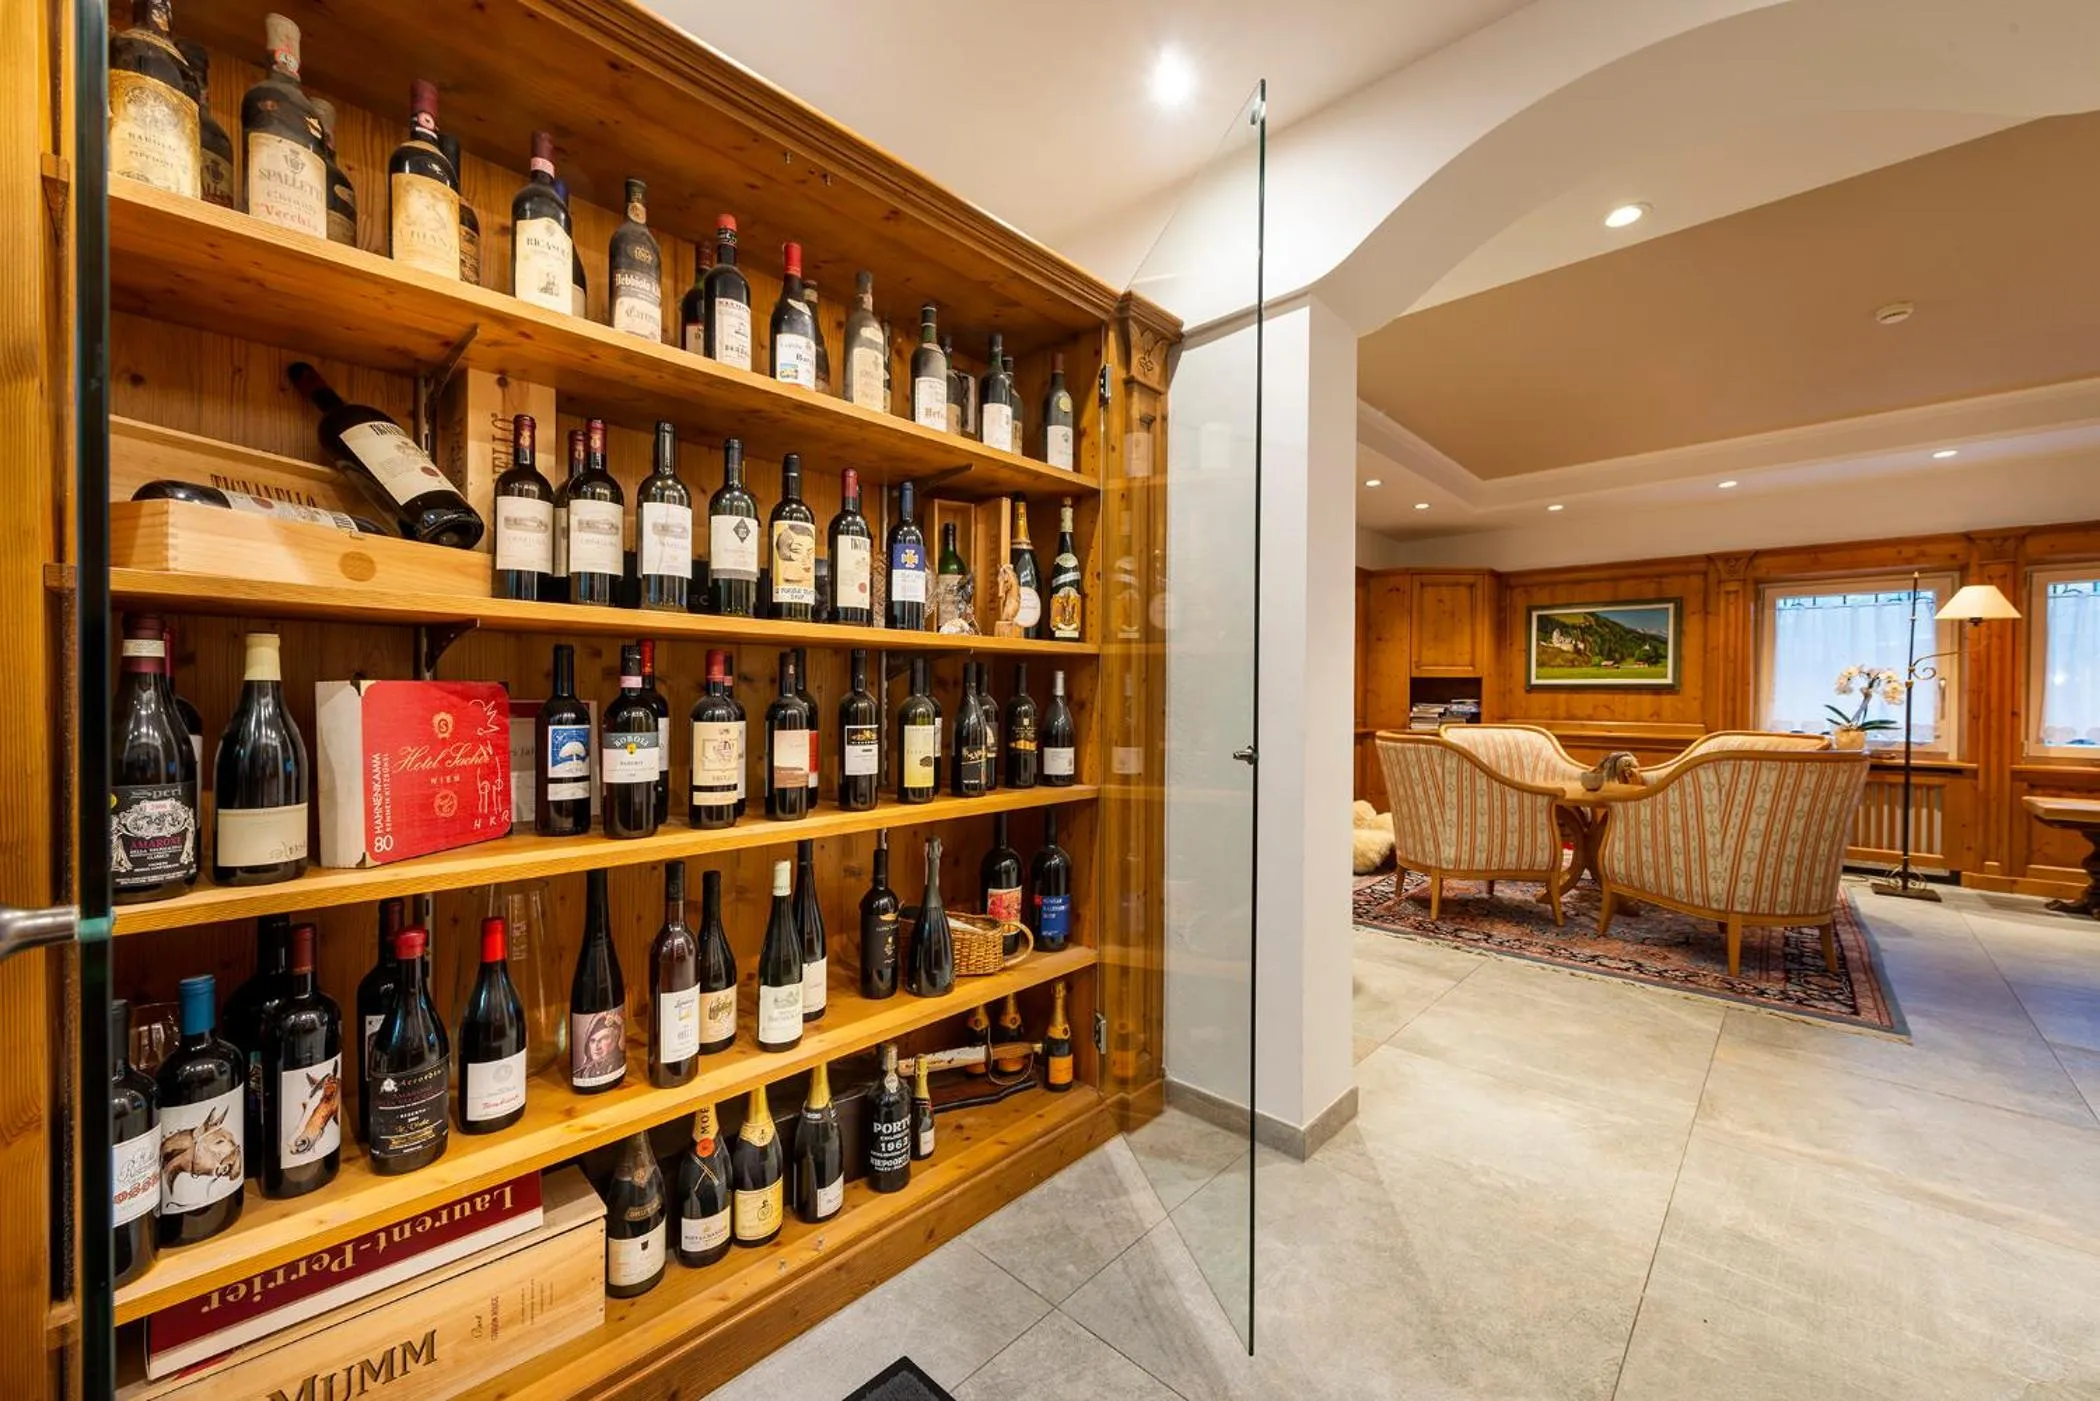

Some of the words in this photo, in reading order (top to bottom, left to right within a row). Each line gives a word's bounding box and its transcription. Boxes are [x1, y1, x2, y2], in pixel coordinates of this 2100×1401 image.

[391, 744, 449, 774] Hotel
[445, 742, 490, 769] Sacher
[430, 774, 460, 785] WIEN
[374, 834, 394, 853] 80
[201, 1184, 514, 1313] Laurent-Perrier
[266, 1328, 438, 1401] MUMM
